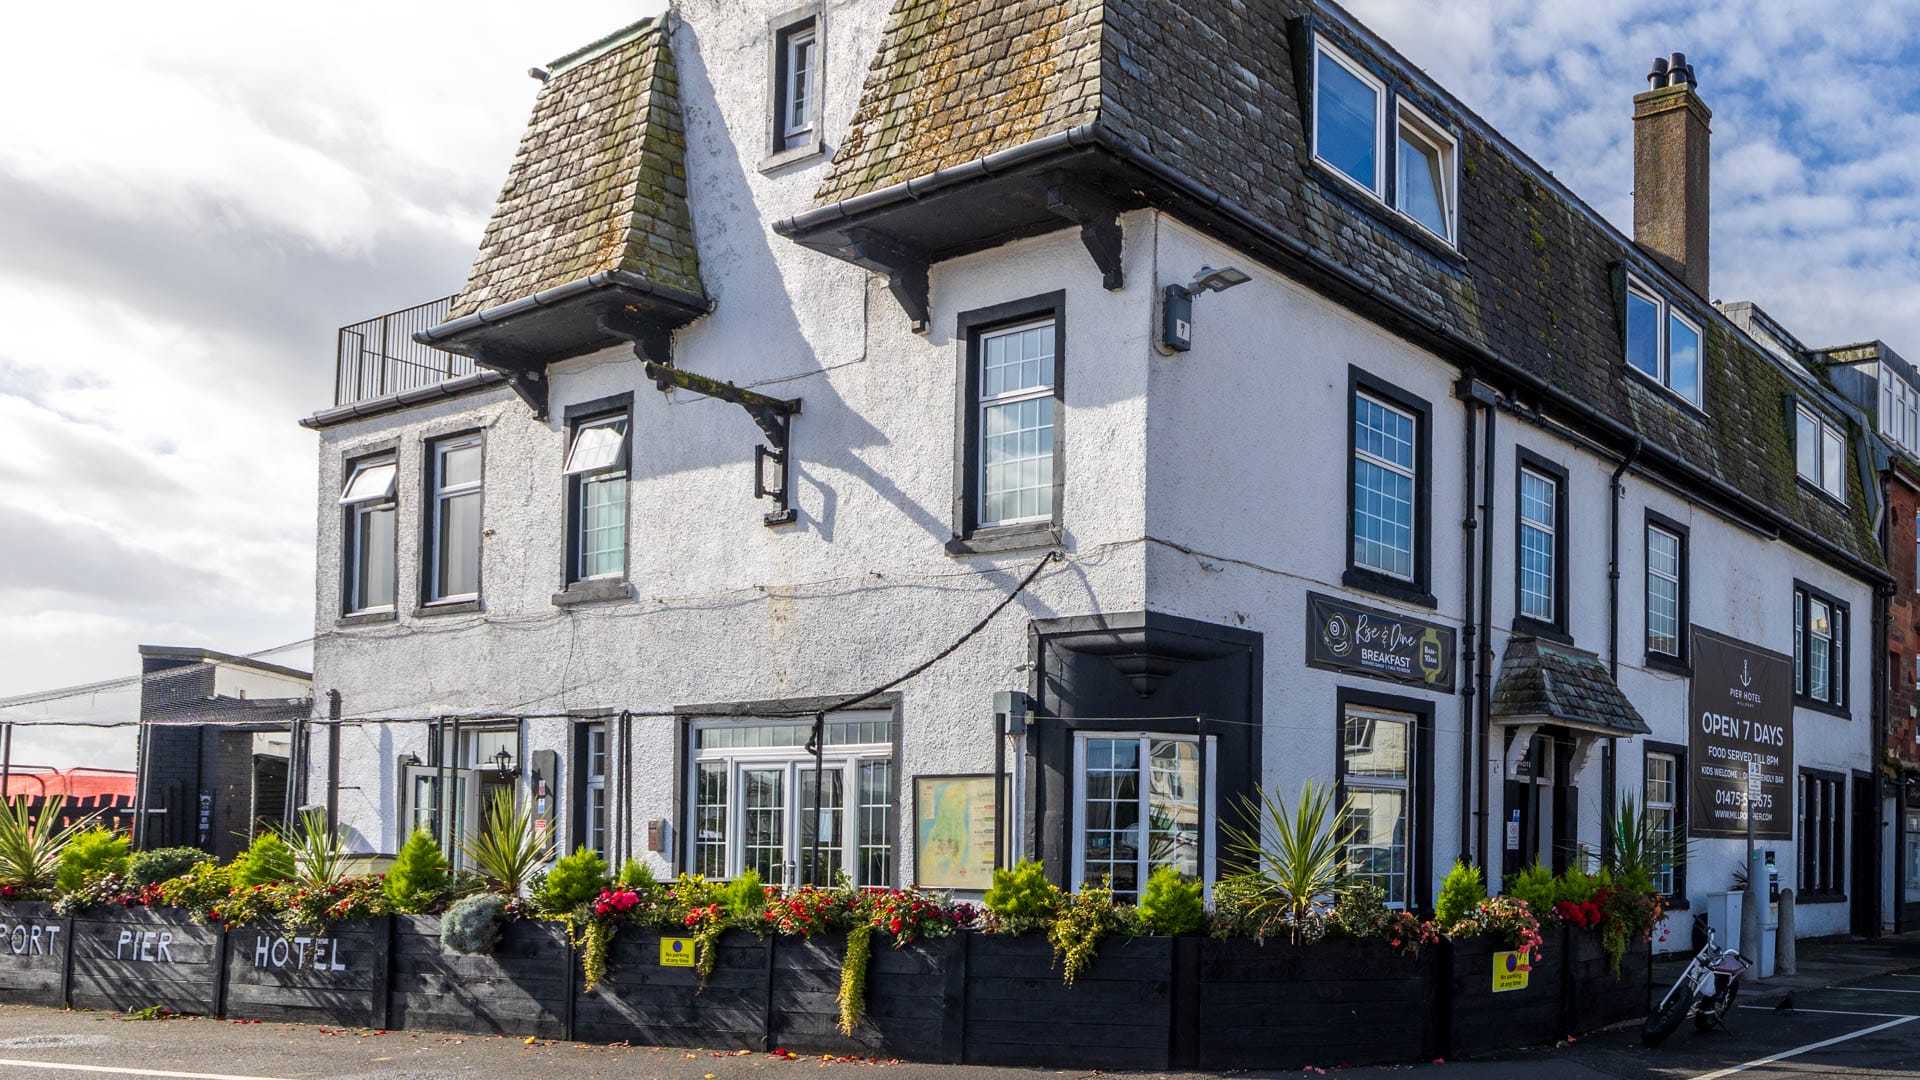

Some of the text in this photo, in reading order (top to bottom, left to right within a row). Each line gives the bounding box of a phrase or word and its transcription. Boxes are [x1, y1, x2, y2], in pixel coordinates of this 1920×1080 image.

[1355, 614, 1417, 652] Rise & Dine
[1361, 648, 1411, 668] BREAKFAST
[1729, 687, 1761, 704] PIER HOTEL
[1702, 711, 1784, 746] OPEN 7 DAYS
[1708, 745, 1779, 766] FOOD SERVED TILL 8PM
[1701, 766, 1713, 776] KIDS
[1714, 767, 1738, 779] WELCOME
[1775, 775, 1784, 784] BAR
[1715, 789, 1741, 806] 01475
[117, 930, 174, 962] PIER
[254, 935, 346, 971] HOTEL
